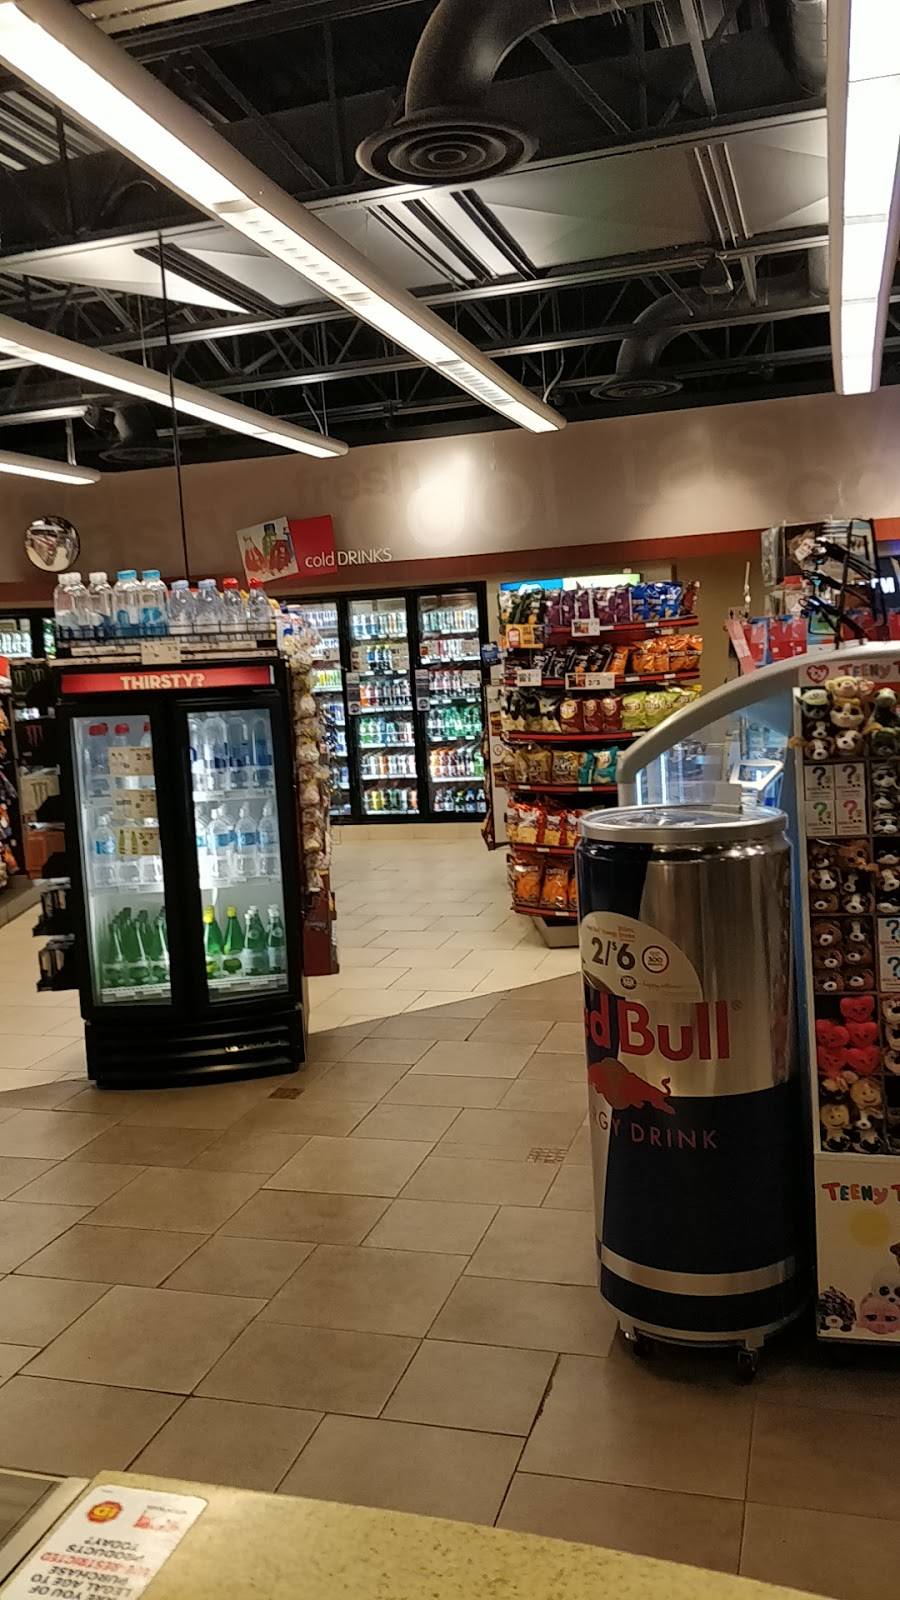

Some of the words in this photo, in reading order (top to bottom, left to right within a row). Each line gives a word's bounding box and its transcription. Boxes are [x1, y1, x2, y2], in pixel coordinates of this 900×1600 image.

[304, 551, 335, 568] cold
[337, 548, 393, 566] DRINKS
[837, 663, 892, 680] TEENY
[119, 672, 206, 691] THIRSTY?
[616, 1000, 730, 1062] Bull
[630, 1121, 718, 1150] DRINK
[821, 1182, 888, 1205] TEENY
[65, 1543, 146, 1561] PRODUCTS
[30, 1573, 50, 1584] TO
[47, 1565, 130, 1586] PURCHASE
[52, 1576, 84, 1589] AGE
[27, 1584, 51, 1596] OF
[86, 1581, 133, 1598] LEGAL
